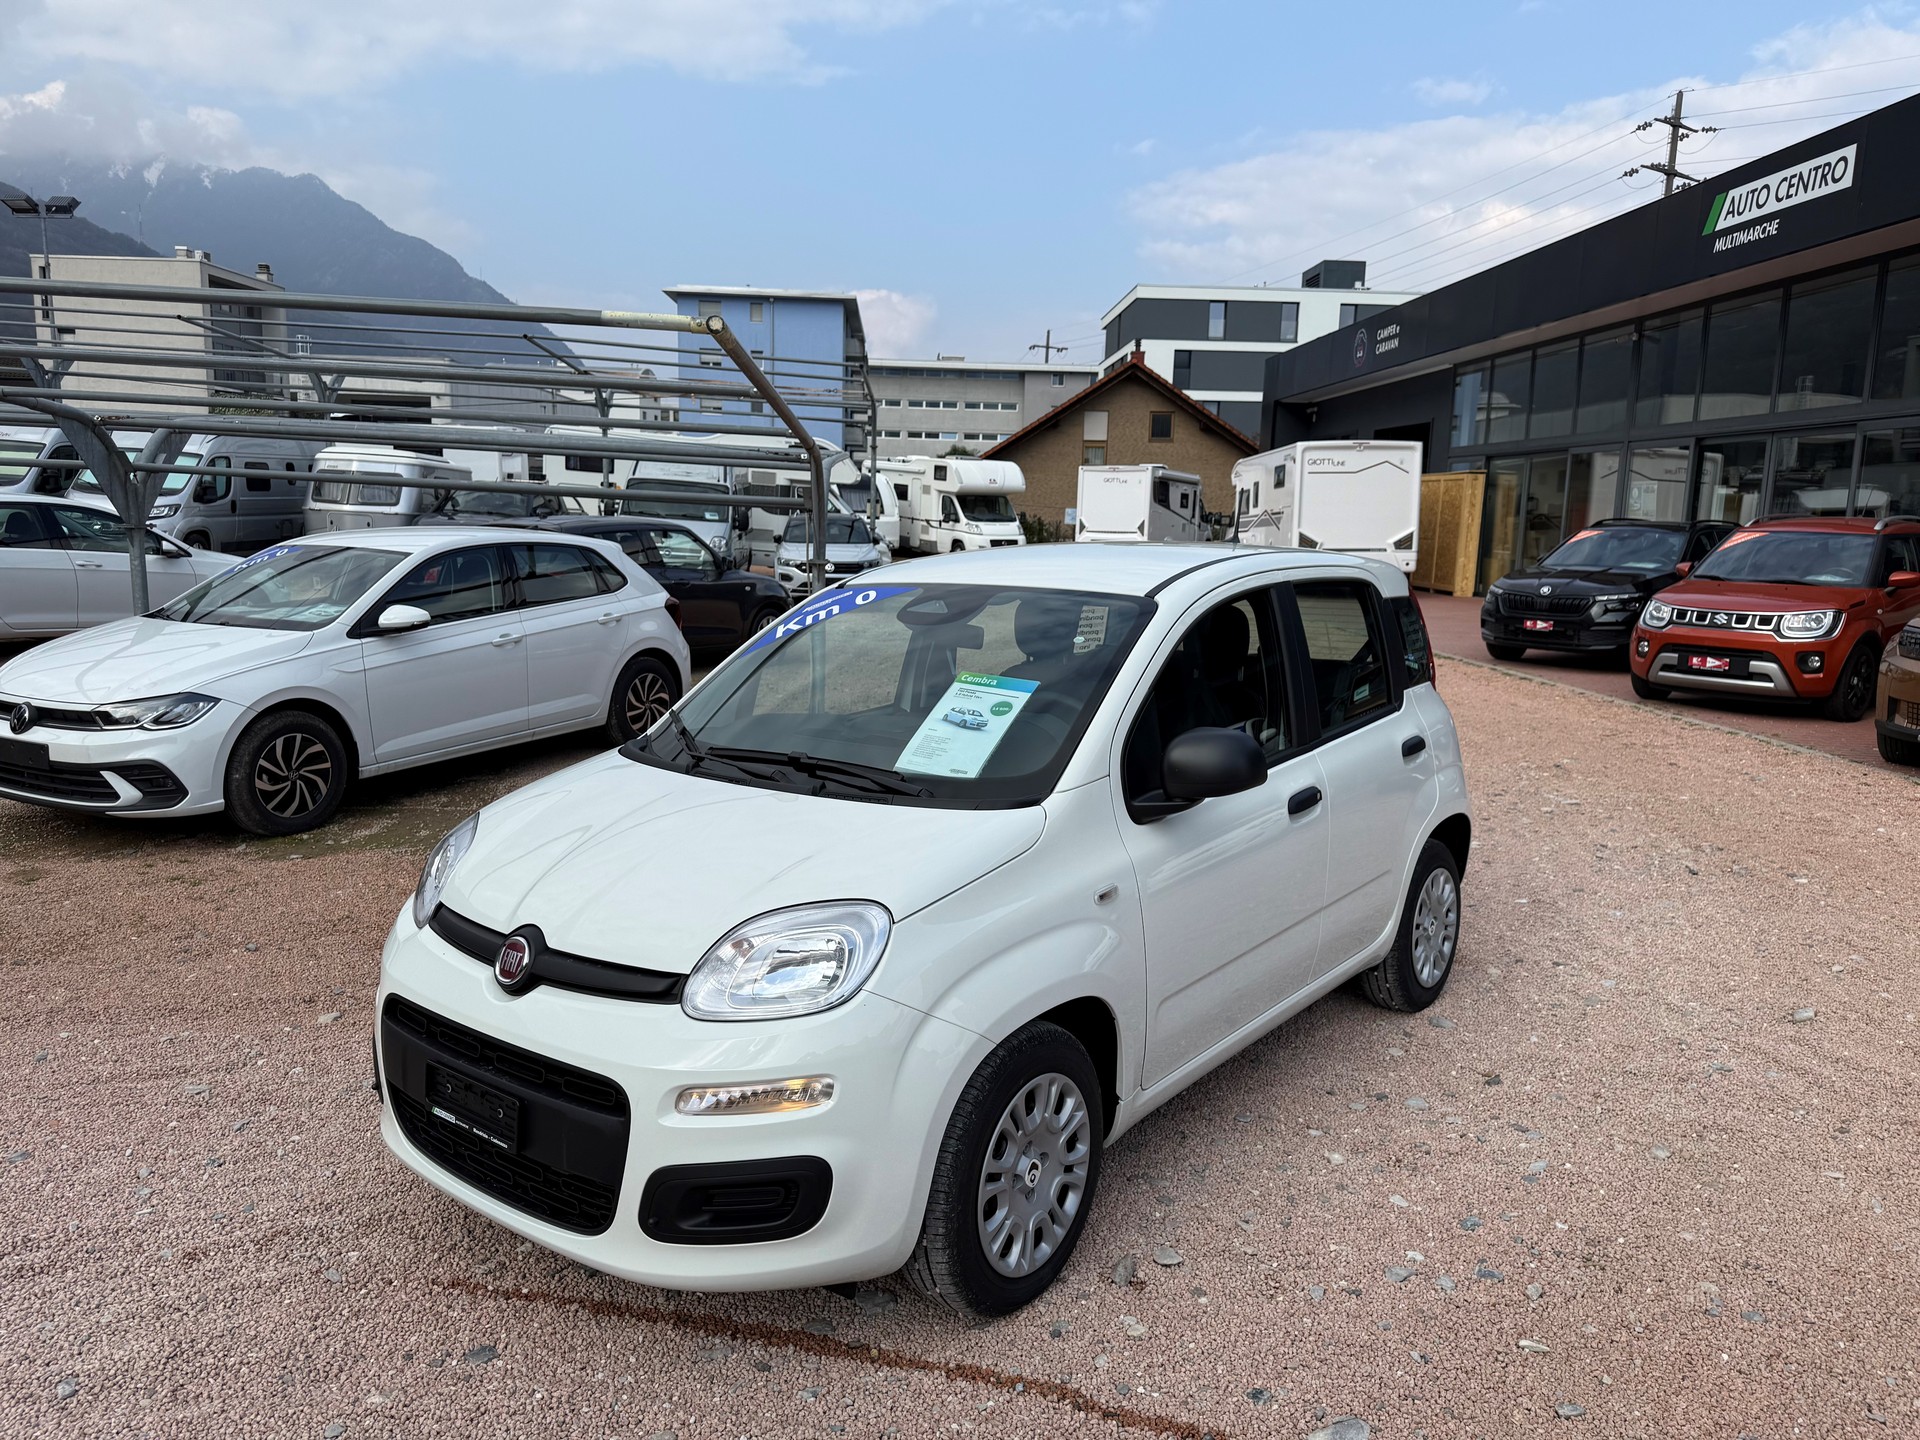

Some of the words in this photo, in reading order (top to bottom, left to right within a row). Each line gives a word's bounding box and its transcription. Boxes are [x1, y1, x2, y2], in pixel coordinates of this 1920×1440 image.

[1723, 183, 1771, 221] AUTO
[1775, 155, 1849, 203] CENTRO
[1713, 218, 1780, 254] MULTIMARCHE
[1376, 323, 1396, 341] CAMPER
[1375, 337, 1400, 355] CARAVAN
[775, 604, 840, 639] Km
[855, 590, 877, 605] 0
[961, 674, 998, 686] Cembra
[500, 948, 523, 974] FIAT
